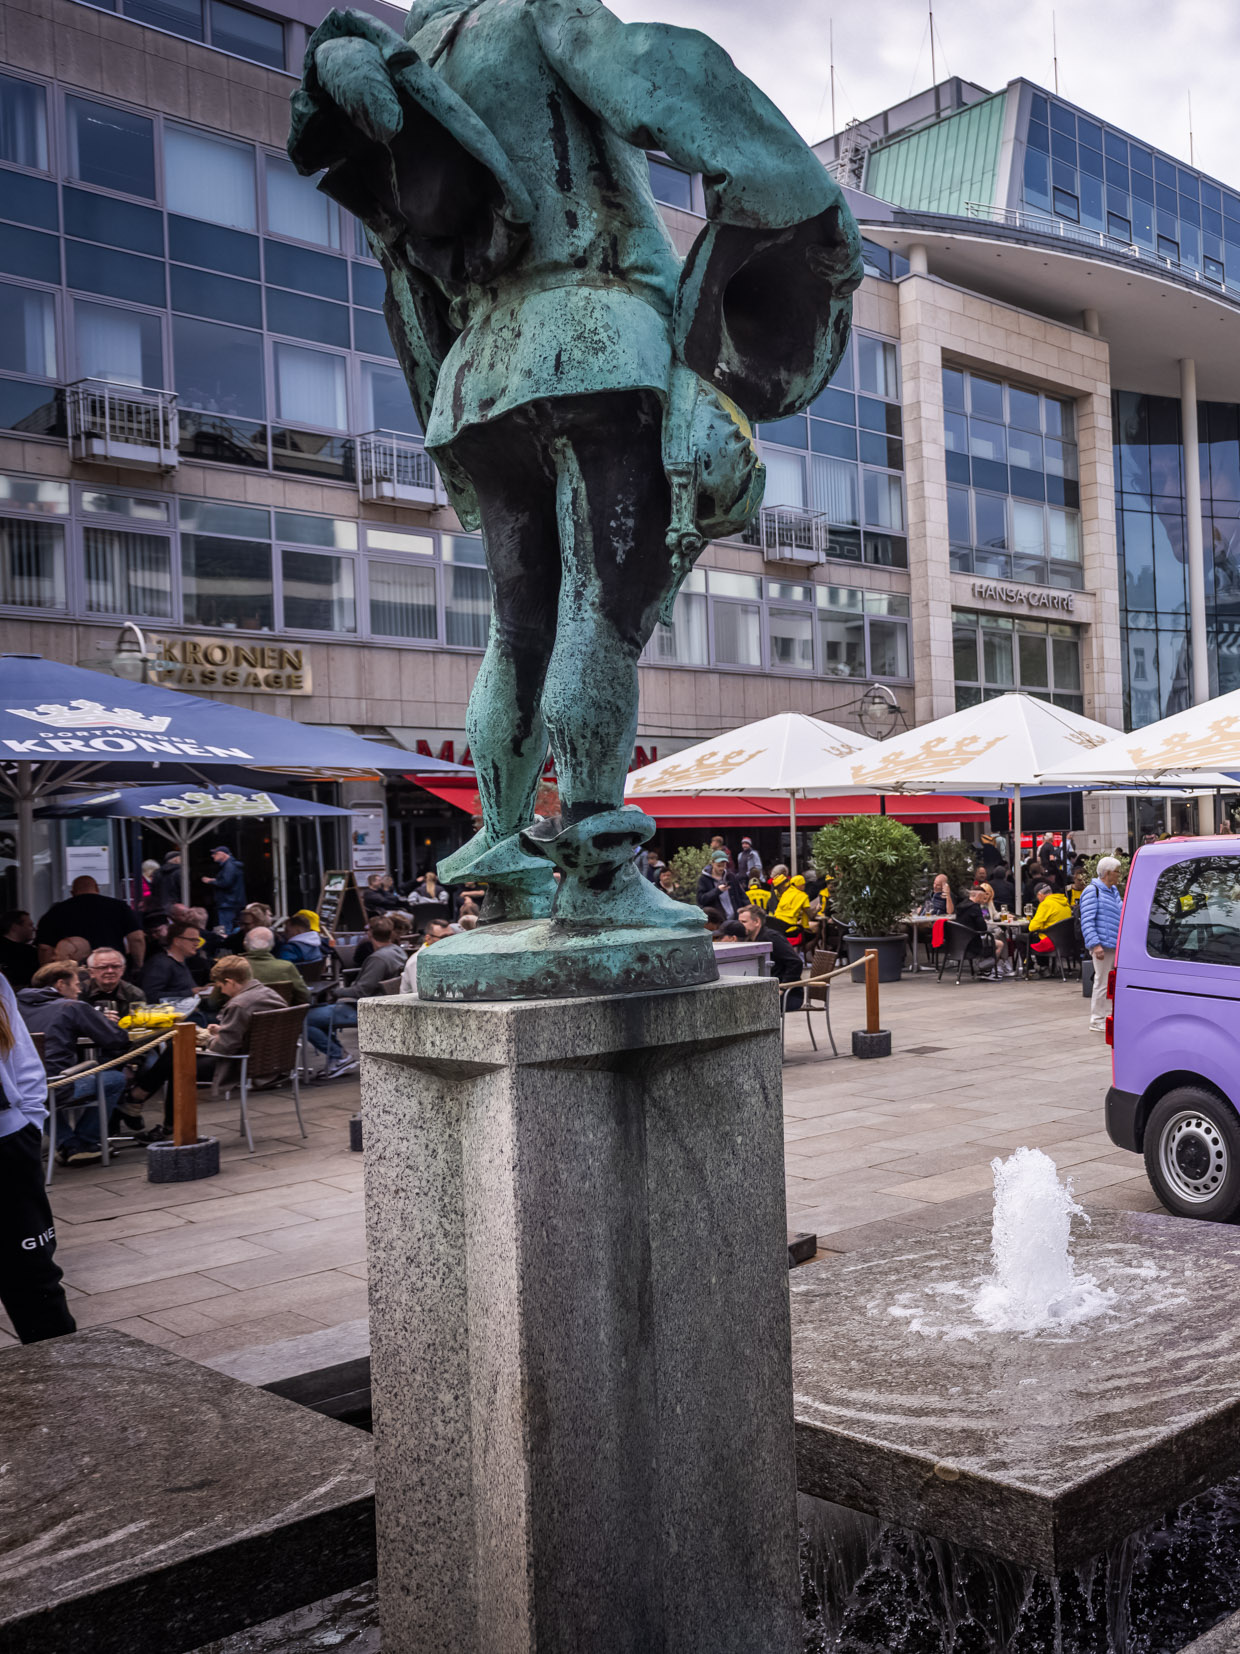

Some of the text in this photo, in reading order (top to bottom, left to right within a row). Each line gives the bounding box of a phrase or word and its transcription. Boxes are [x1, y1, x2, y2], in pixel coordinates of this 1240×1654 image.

[157, 639, 303, 671] KRONEN
[158, 668, 304, 689] PASSAGE
[38, 729, 198, 744] DORTMUNDER
[1, 737, 255, 759] KRONEN
